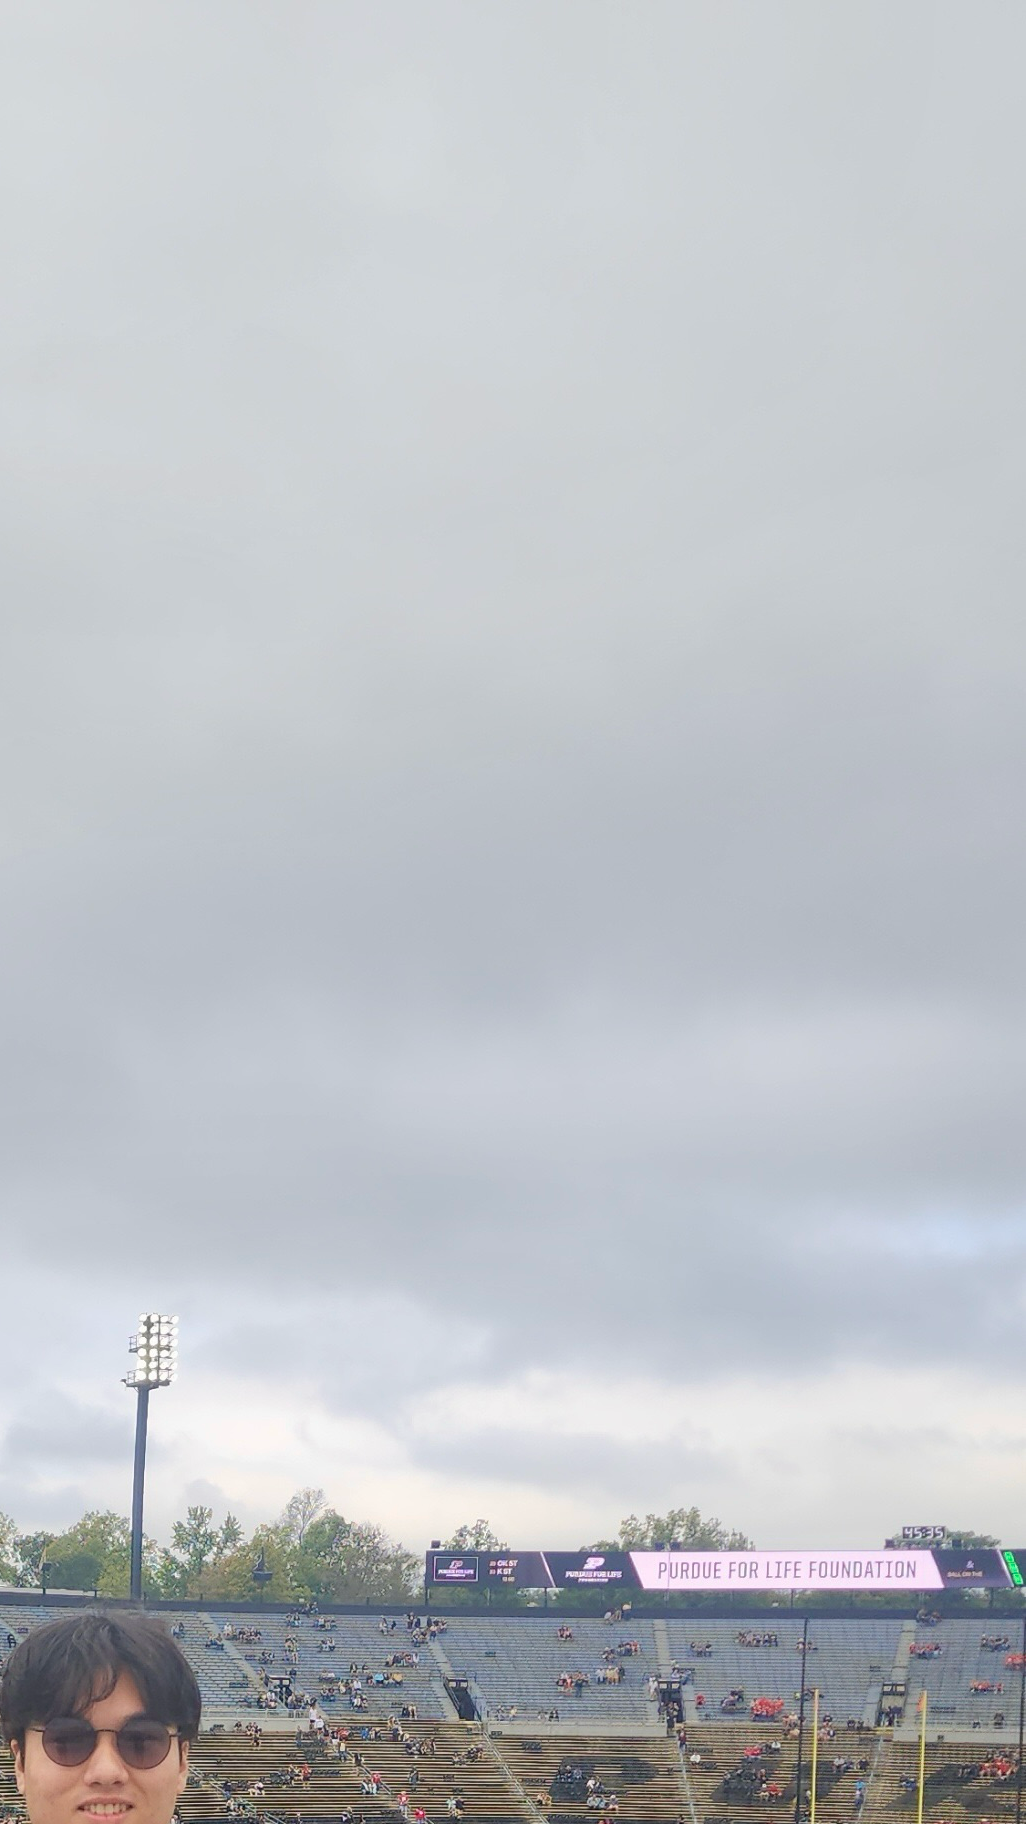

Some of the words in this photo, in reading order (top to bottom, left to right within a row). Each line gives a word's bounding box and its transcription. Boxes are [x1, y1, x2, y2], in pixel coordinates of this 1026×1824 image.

[903, 1526, 944, 1539] 45:35
[657, 1560, 722, 1580] PURDUE
[728, 1561, 759, 1579] FOR
[765, 1560, 802, 1579] LIFE
[808, 1560, 917, 1580] FOUNDATION
